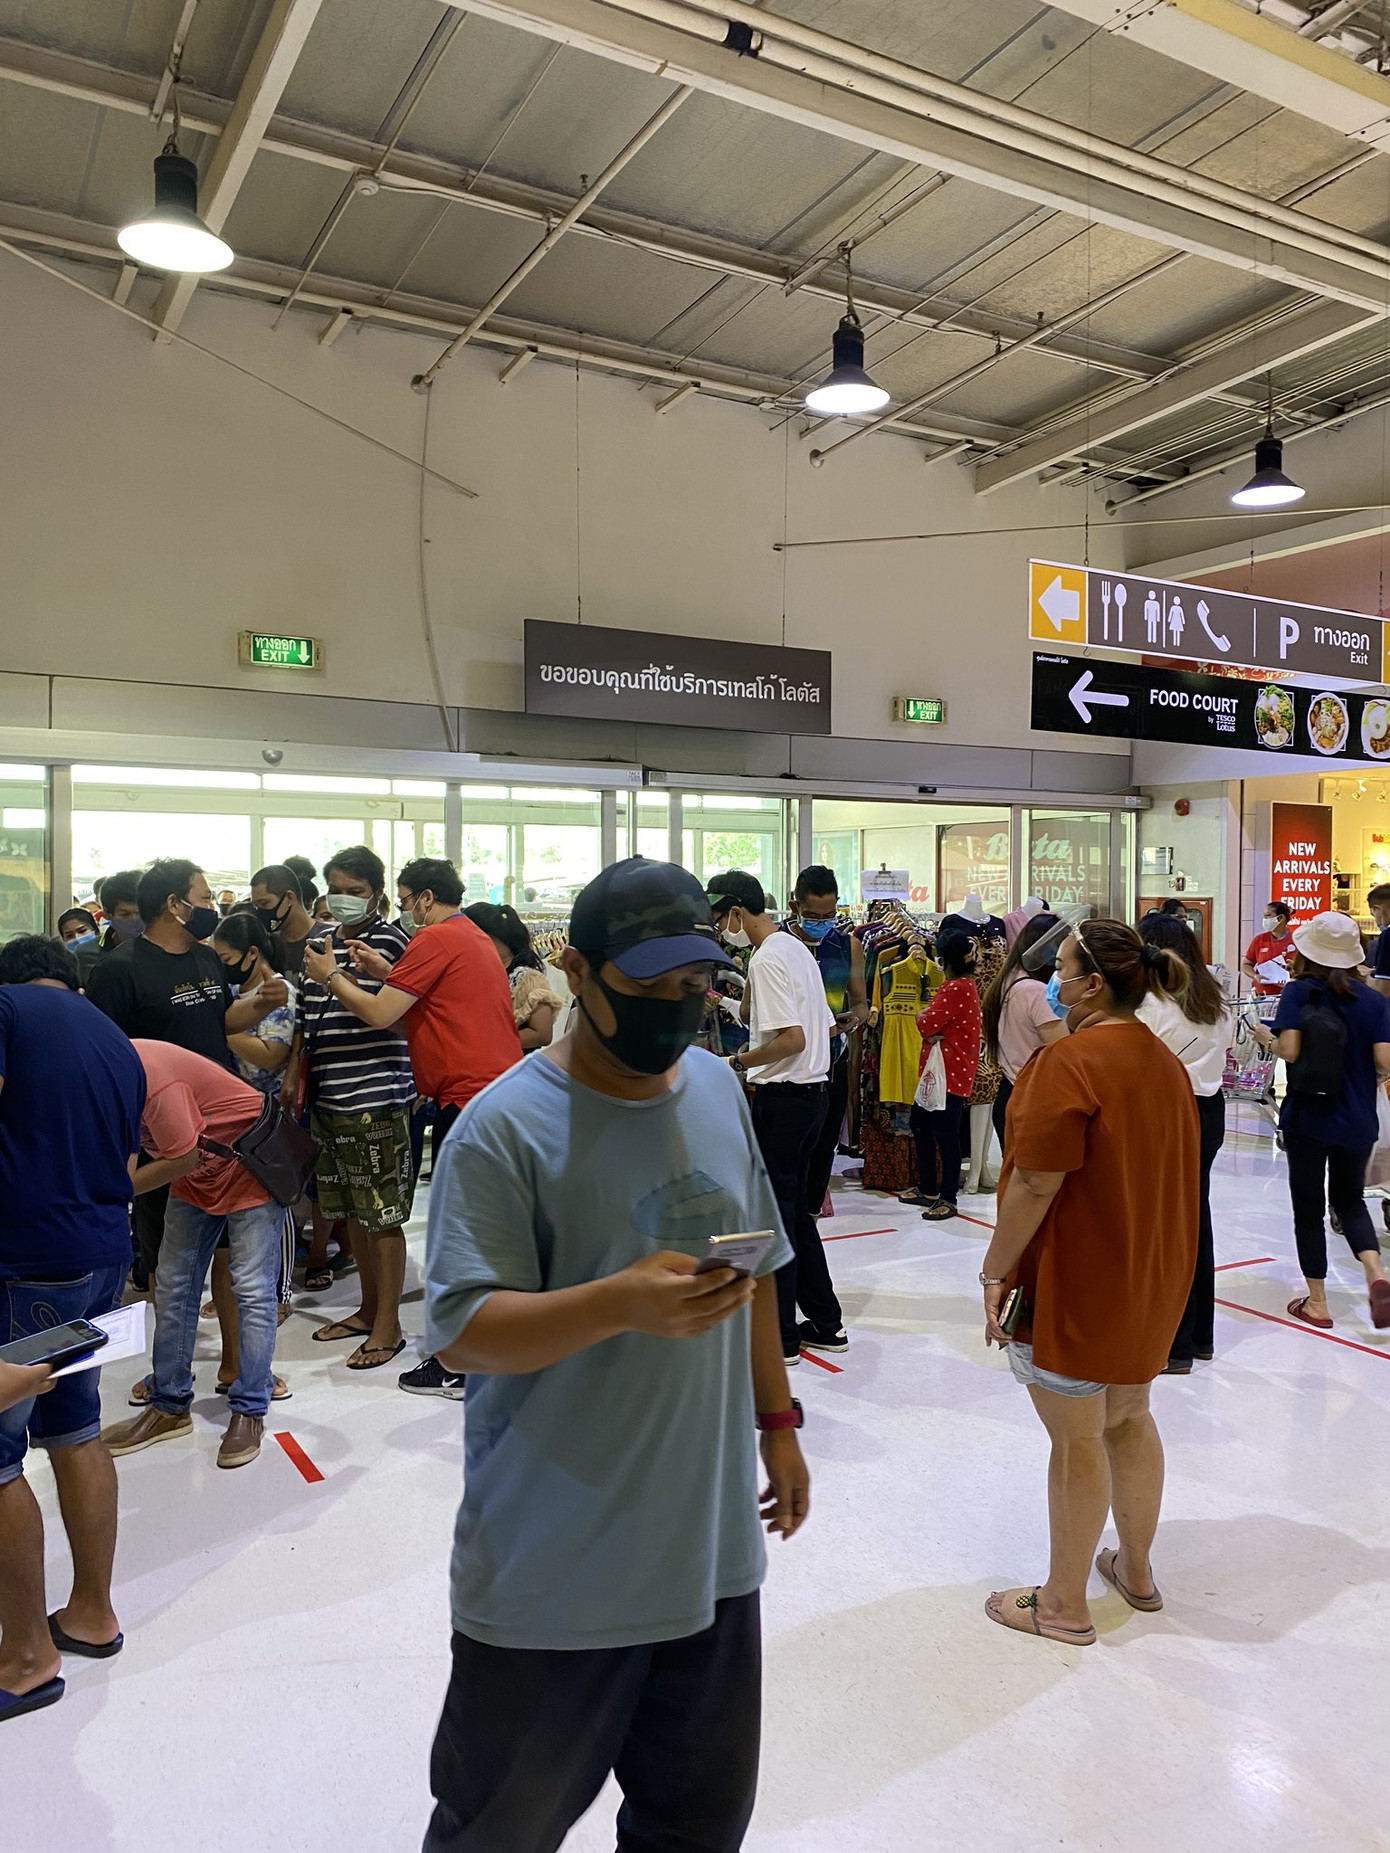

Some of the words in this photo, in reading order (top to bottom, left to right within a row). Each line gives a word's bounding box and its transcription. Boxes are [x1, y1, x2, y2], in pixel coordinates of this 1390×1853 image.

[255, 636, 297, 652] ทางออก
[1280, 616, 1300, 660] P
[1313, 626, 1370, 651] ทางออก
[261, 649, 290, 662] EXIT
[1350, 651, 1369, 665] Exit
[1150, 688, 1189, 708] FOOD
[1192, 693, 1239, 714] COURT
[920, 711, 938, 720] EXIT
[1207, 715, 1214, 724] by
[1216, 714, 1236, 723] TESCO
[1216, 722, 1236, 733] Lotus
[983, 832, 1071, 861] Bta
[1288, 842, 1317, 857] NEW
[1274, 860, 1331, 875] ARRIVALS
[1282, 878, 1321, 892] EVERY
[369, 1143, 381, 1174] Zebra
